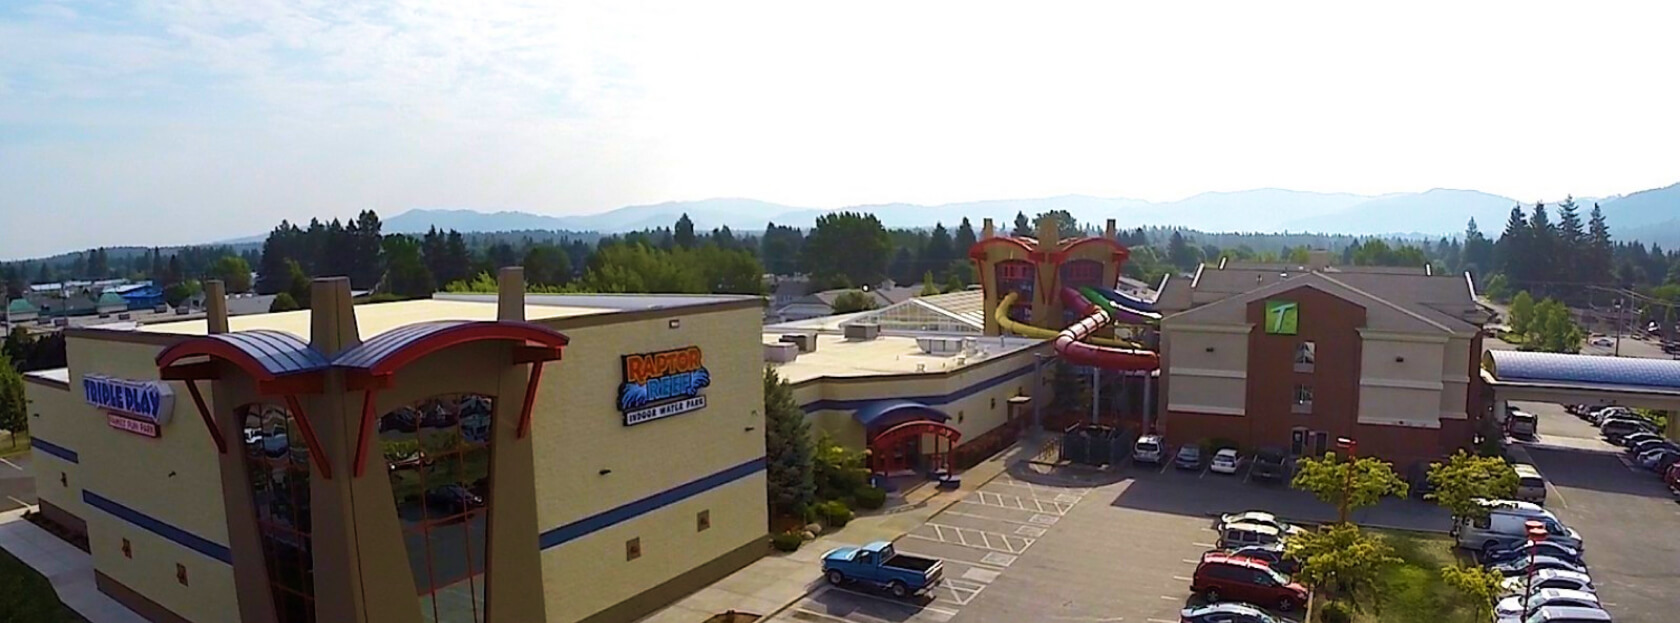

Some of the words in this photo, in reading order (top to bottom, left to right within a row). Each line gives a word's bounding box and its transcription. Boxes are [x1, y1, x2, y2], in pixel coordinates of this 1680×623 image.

[626, 348, 701, 386] RAPTOR
[84, 379, 124, 408] TRIPLE
[125, 386, 160, 418] PLAY
[646, 372, 692, 401] REEF
[629, 409, 657, 423] INDOOR
[660, 403, 683, 414] WATER
[686, 398, 703, 408] PARK
[127, 419, 139, 430] FUN
[140, 422, 153, 433] PARK
